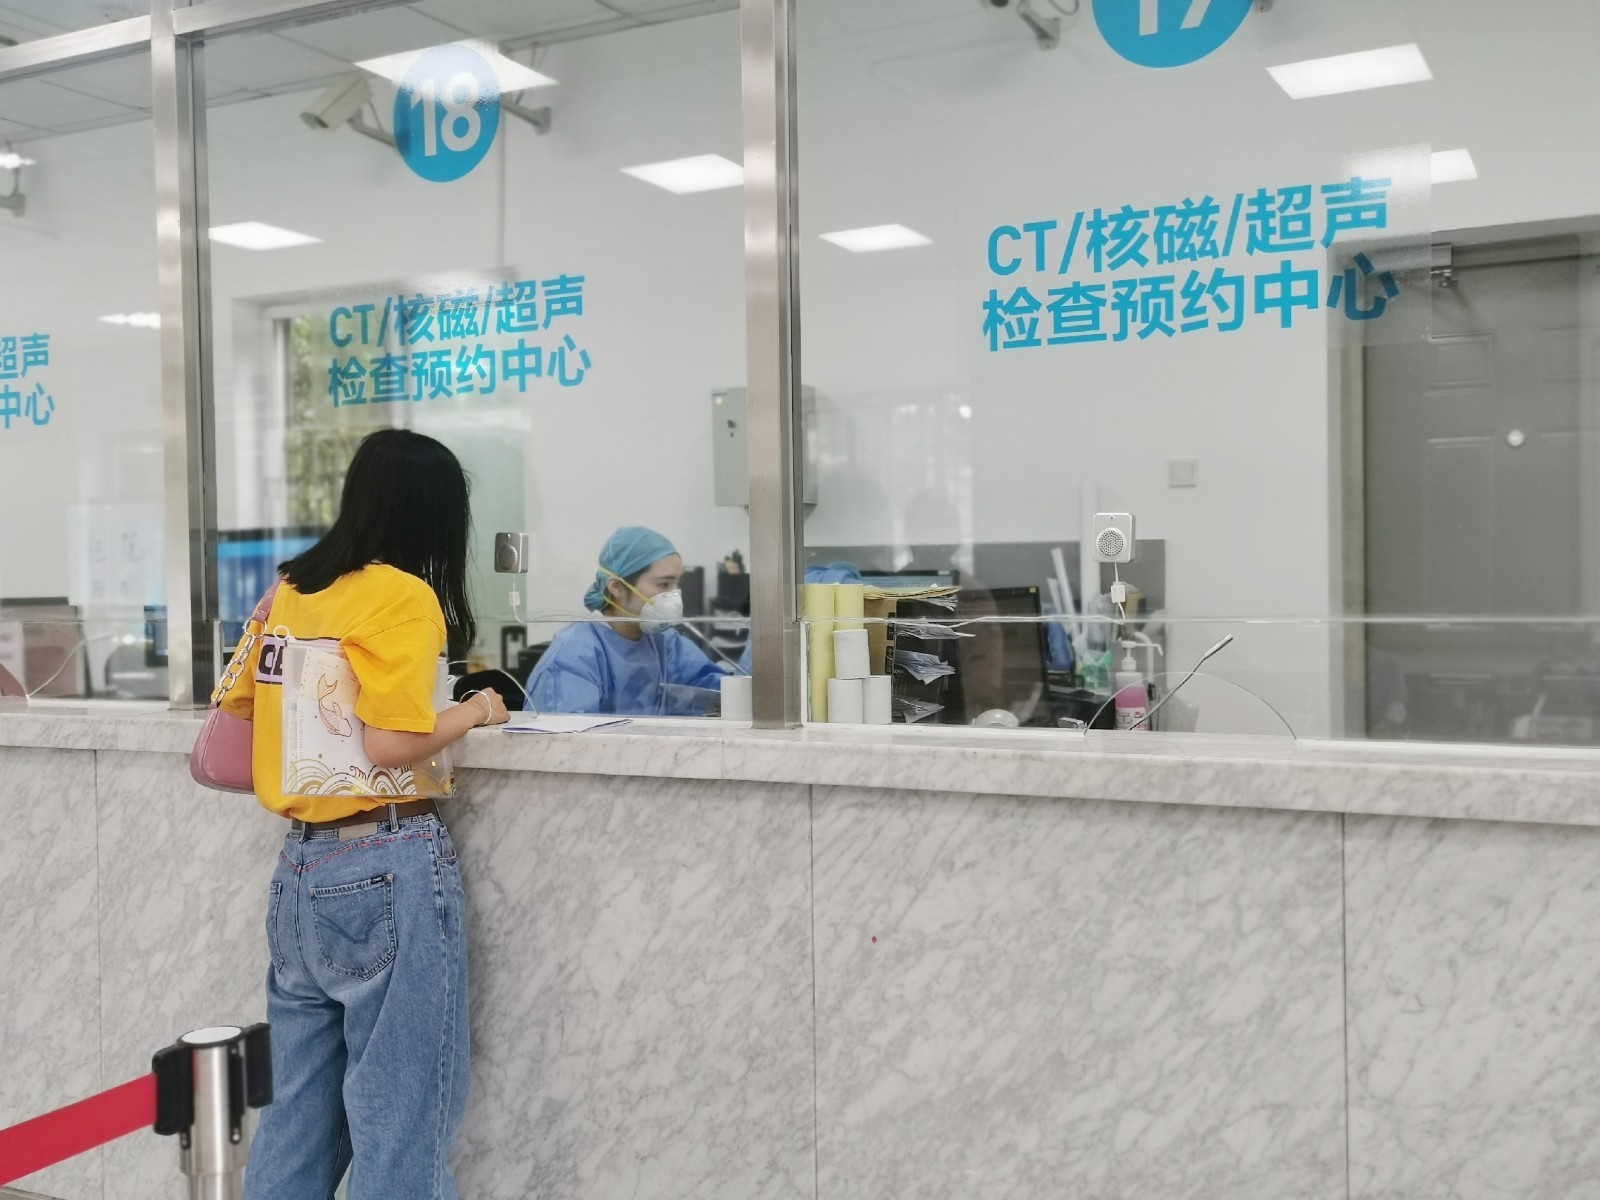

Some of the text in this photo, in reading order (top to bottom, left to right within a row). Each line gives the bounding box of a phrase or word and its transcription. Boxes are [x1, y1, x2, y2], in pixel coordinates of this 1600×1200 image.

[410, 71, 481, 157] 18
[987, 176, 1392, 276] CT/核磁/超声
[329, 274, 586, 347] CT/核磁/超声
[982, 252, 1400, 352] 检查预约中心
[328, 334, 592, 408] 检查预约中心
